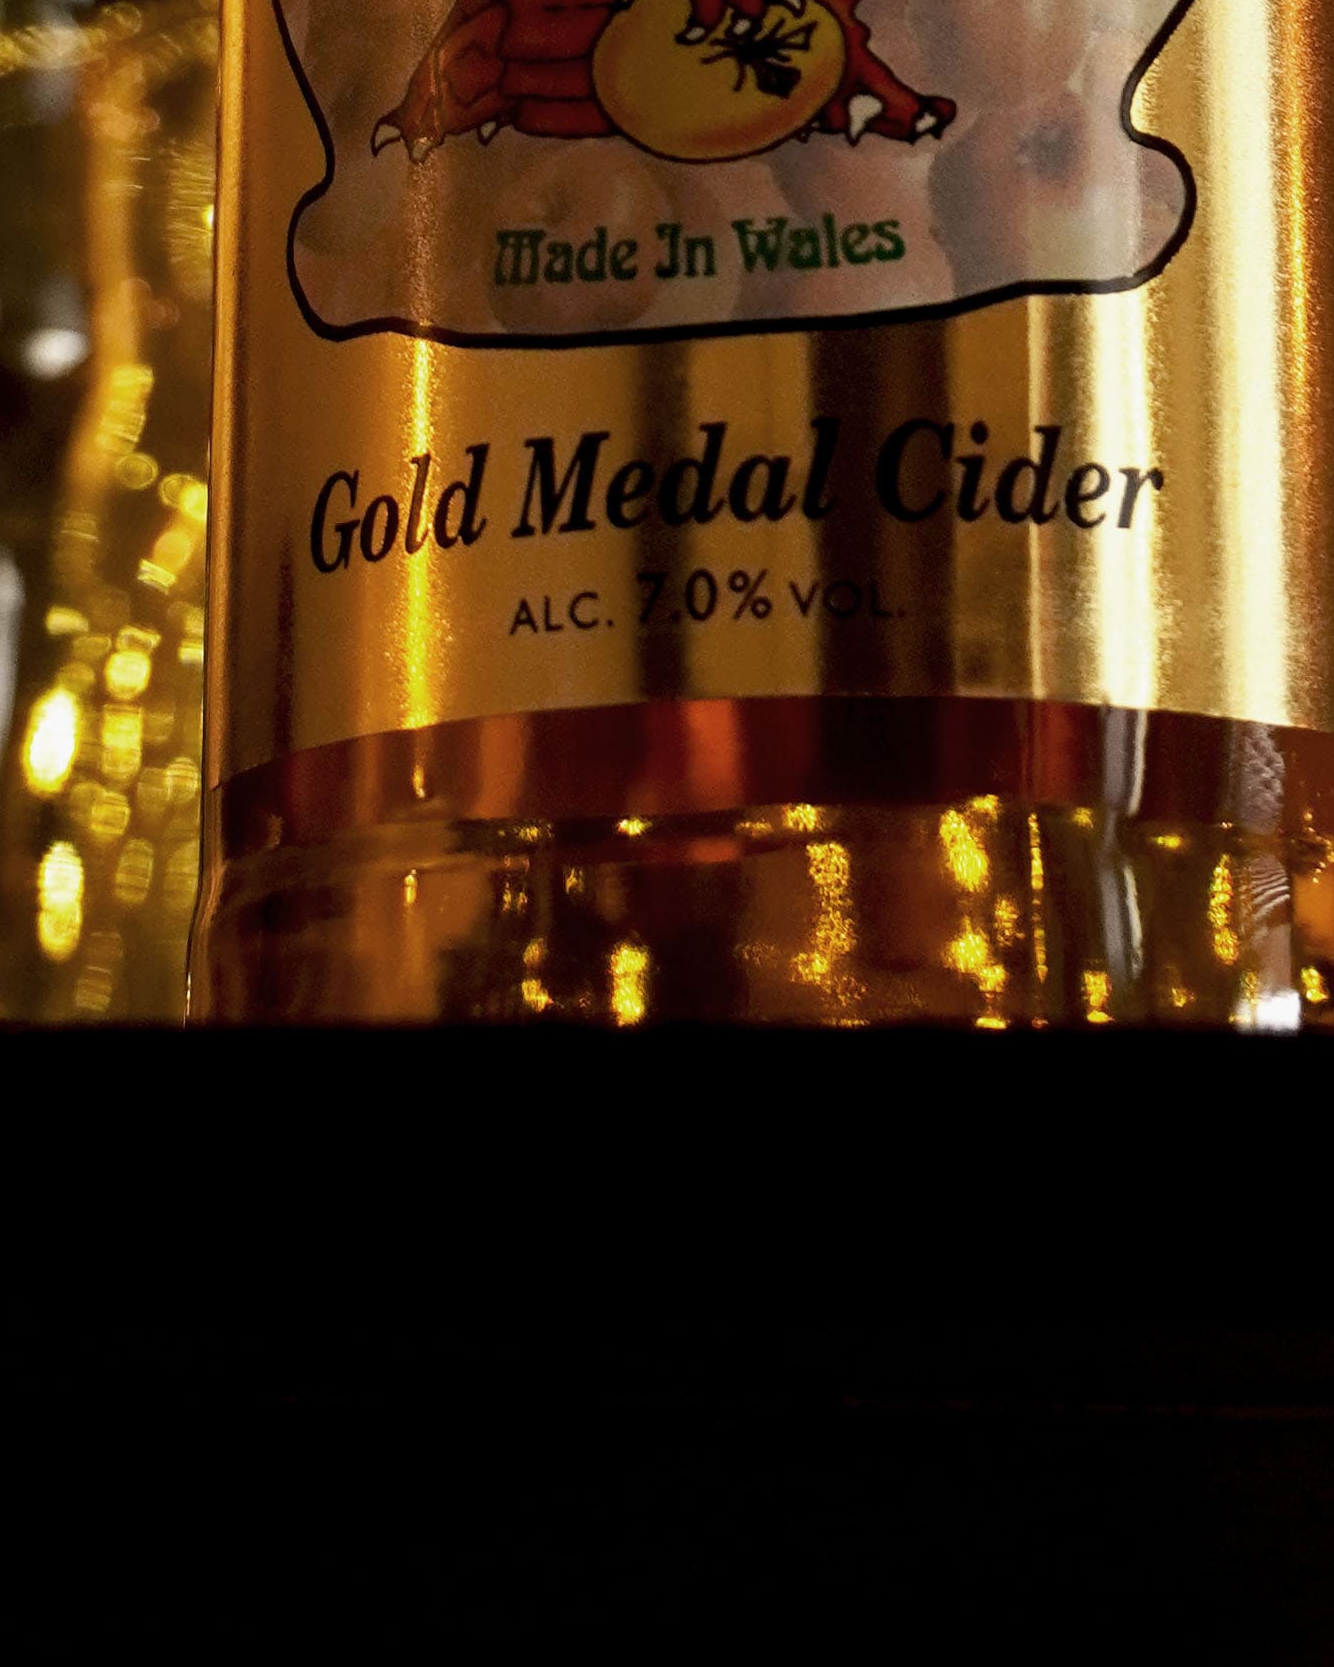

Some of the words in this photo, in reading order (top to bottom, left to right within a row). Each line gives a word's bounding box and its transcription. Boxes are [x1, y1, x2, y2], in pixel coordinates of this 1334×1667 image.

[493, 224, 638, 288] Made
[653, 219, 717, 280] In
[732, 212, 907, 273] Wales
[310, 446, 487, 573] Gold
[513, 419, 839, 539] Medal
[874, 418, 1163, 530] Cider
[509, 592, 615, 636] ALC.
[635, 568, 773, 625] 7.0%
[788, 579, 907, 621] VOL.
